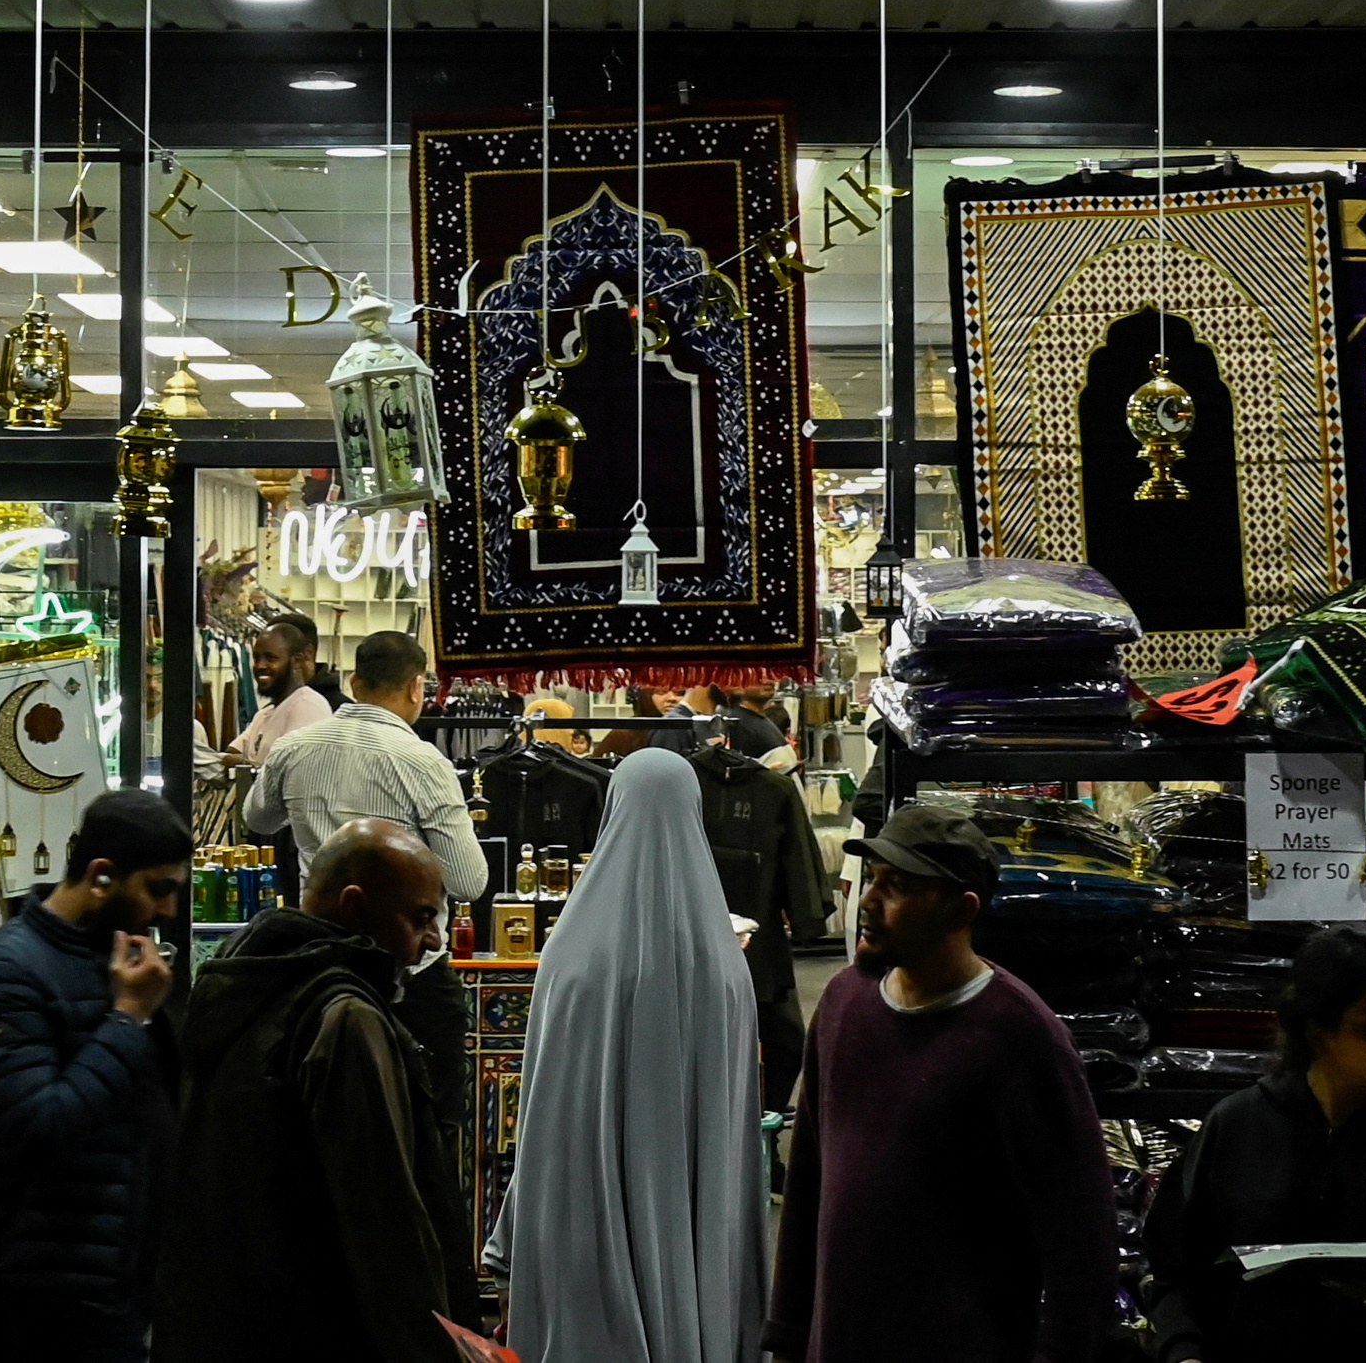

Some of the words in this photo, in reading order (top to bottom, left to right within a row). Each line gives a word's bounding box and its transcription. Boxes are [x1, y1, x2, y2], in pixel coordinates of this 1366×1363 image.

[1269, 774, 1342, 795] Sponge
[1275, 803, 1338, 824] Prayer
[1282, 832, 1331, 850] Mats
[1292, 862, 1320, 880] for
[1326, 863, 1351, 880] 50
